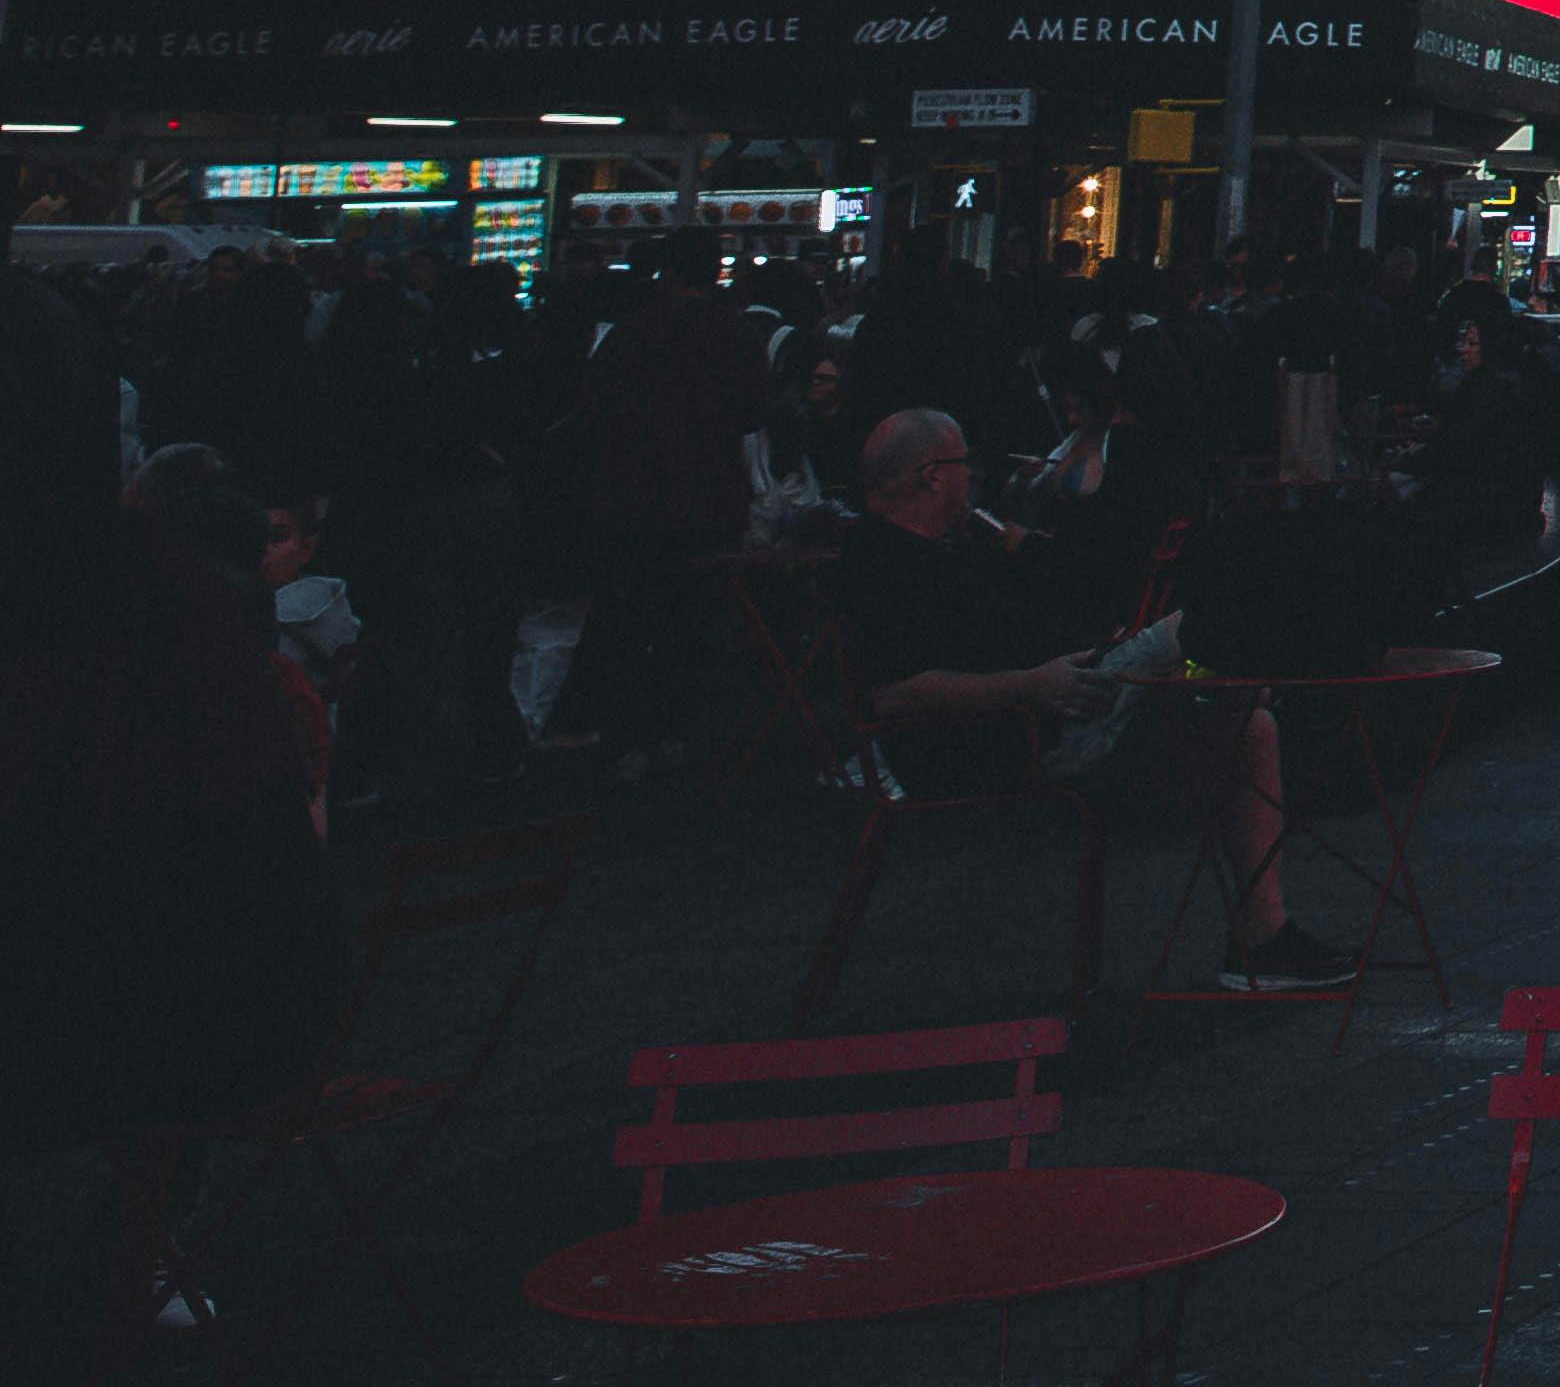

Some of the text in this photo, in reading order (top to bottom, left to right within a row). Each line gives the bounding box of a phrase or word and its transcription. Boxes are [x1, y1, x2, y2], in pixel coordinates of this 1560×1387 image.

[159, 29, 274, 57] EAGLE
[323, 20, 414, 57] aerie
[468, 16, 801, 50] AMERICAN EAGLE
[855, 7, 950, 45] aerie
[1008, 17, 1366, 48] AMERICAN AGLE
